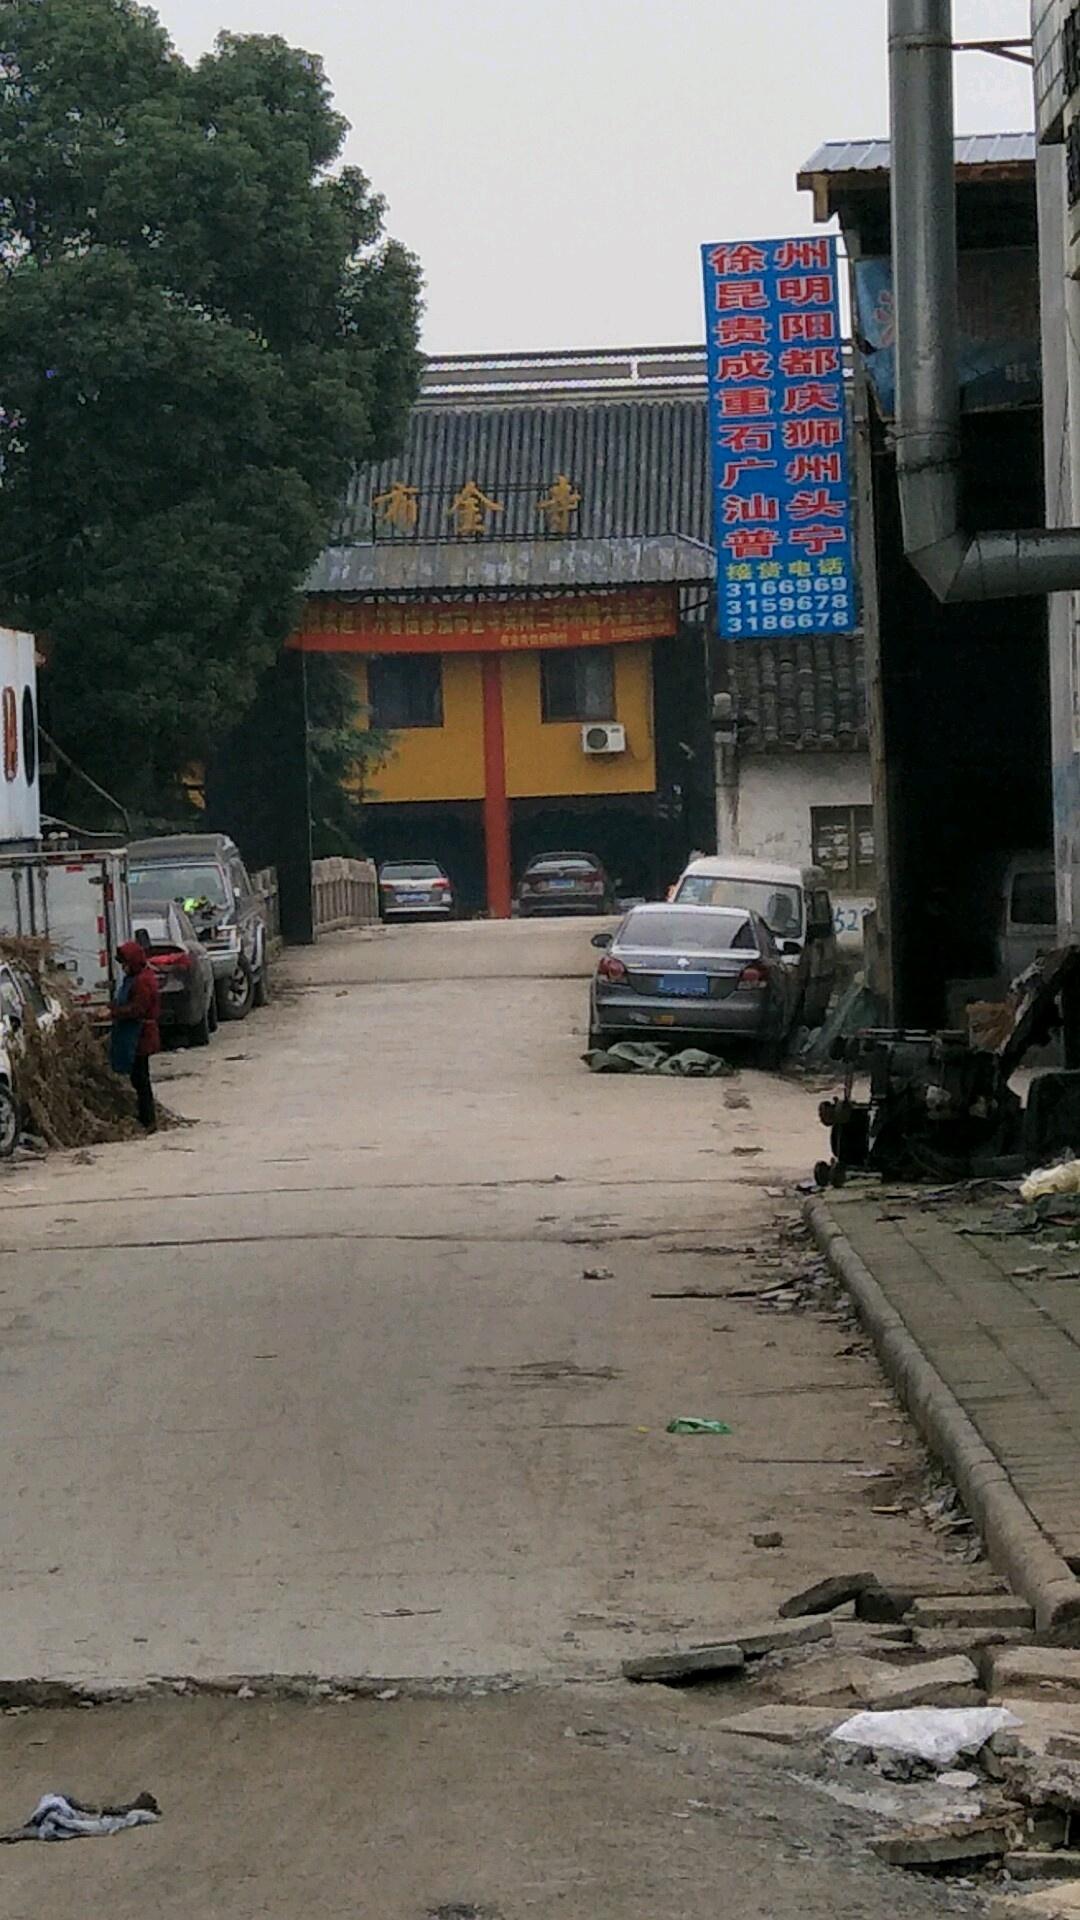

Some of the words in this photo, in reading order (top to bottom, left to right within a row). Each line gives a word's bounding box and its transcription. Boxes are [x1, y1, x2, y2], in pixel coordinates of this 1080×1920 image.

[711, 238, 829, 275] 徐州
[715, 275, 833, 312] 昆明
[714, 312, 834, 348] 贵阳
[717, 347, 838, 382] 成都
[716, 382, 838, 417] 重庆
[719, 418, 843, 453] 石狮
[719, 453, 842, 489] 广州
[721, 488, 846, 524] 汕头
[721, 524, 847, 559] 普宁
[726, 576, 848, 597] 3166969
[726, 594, 848, 615] 3159678
[727, 612, 849, 633] 3186678
